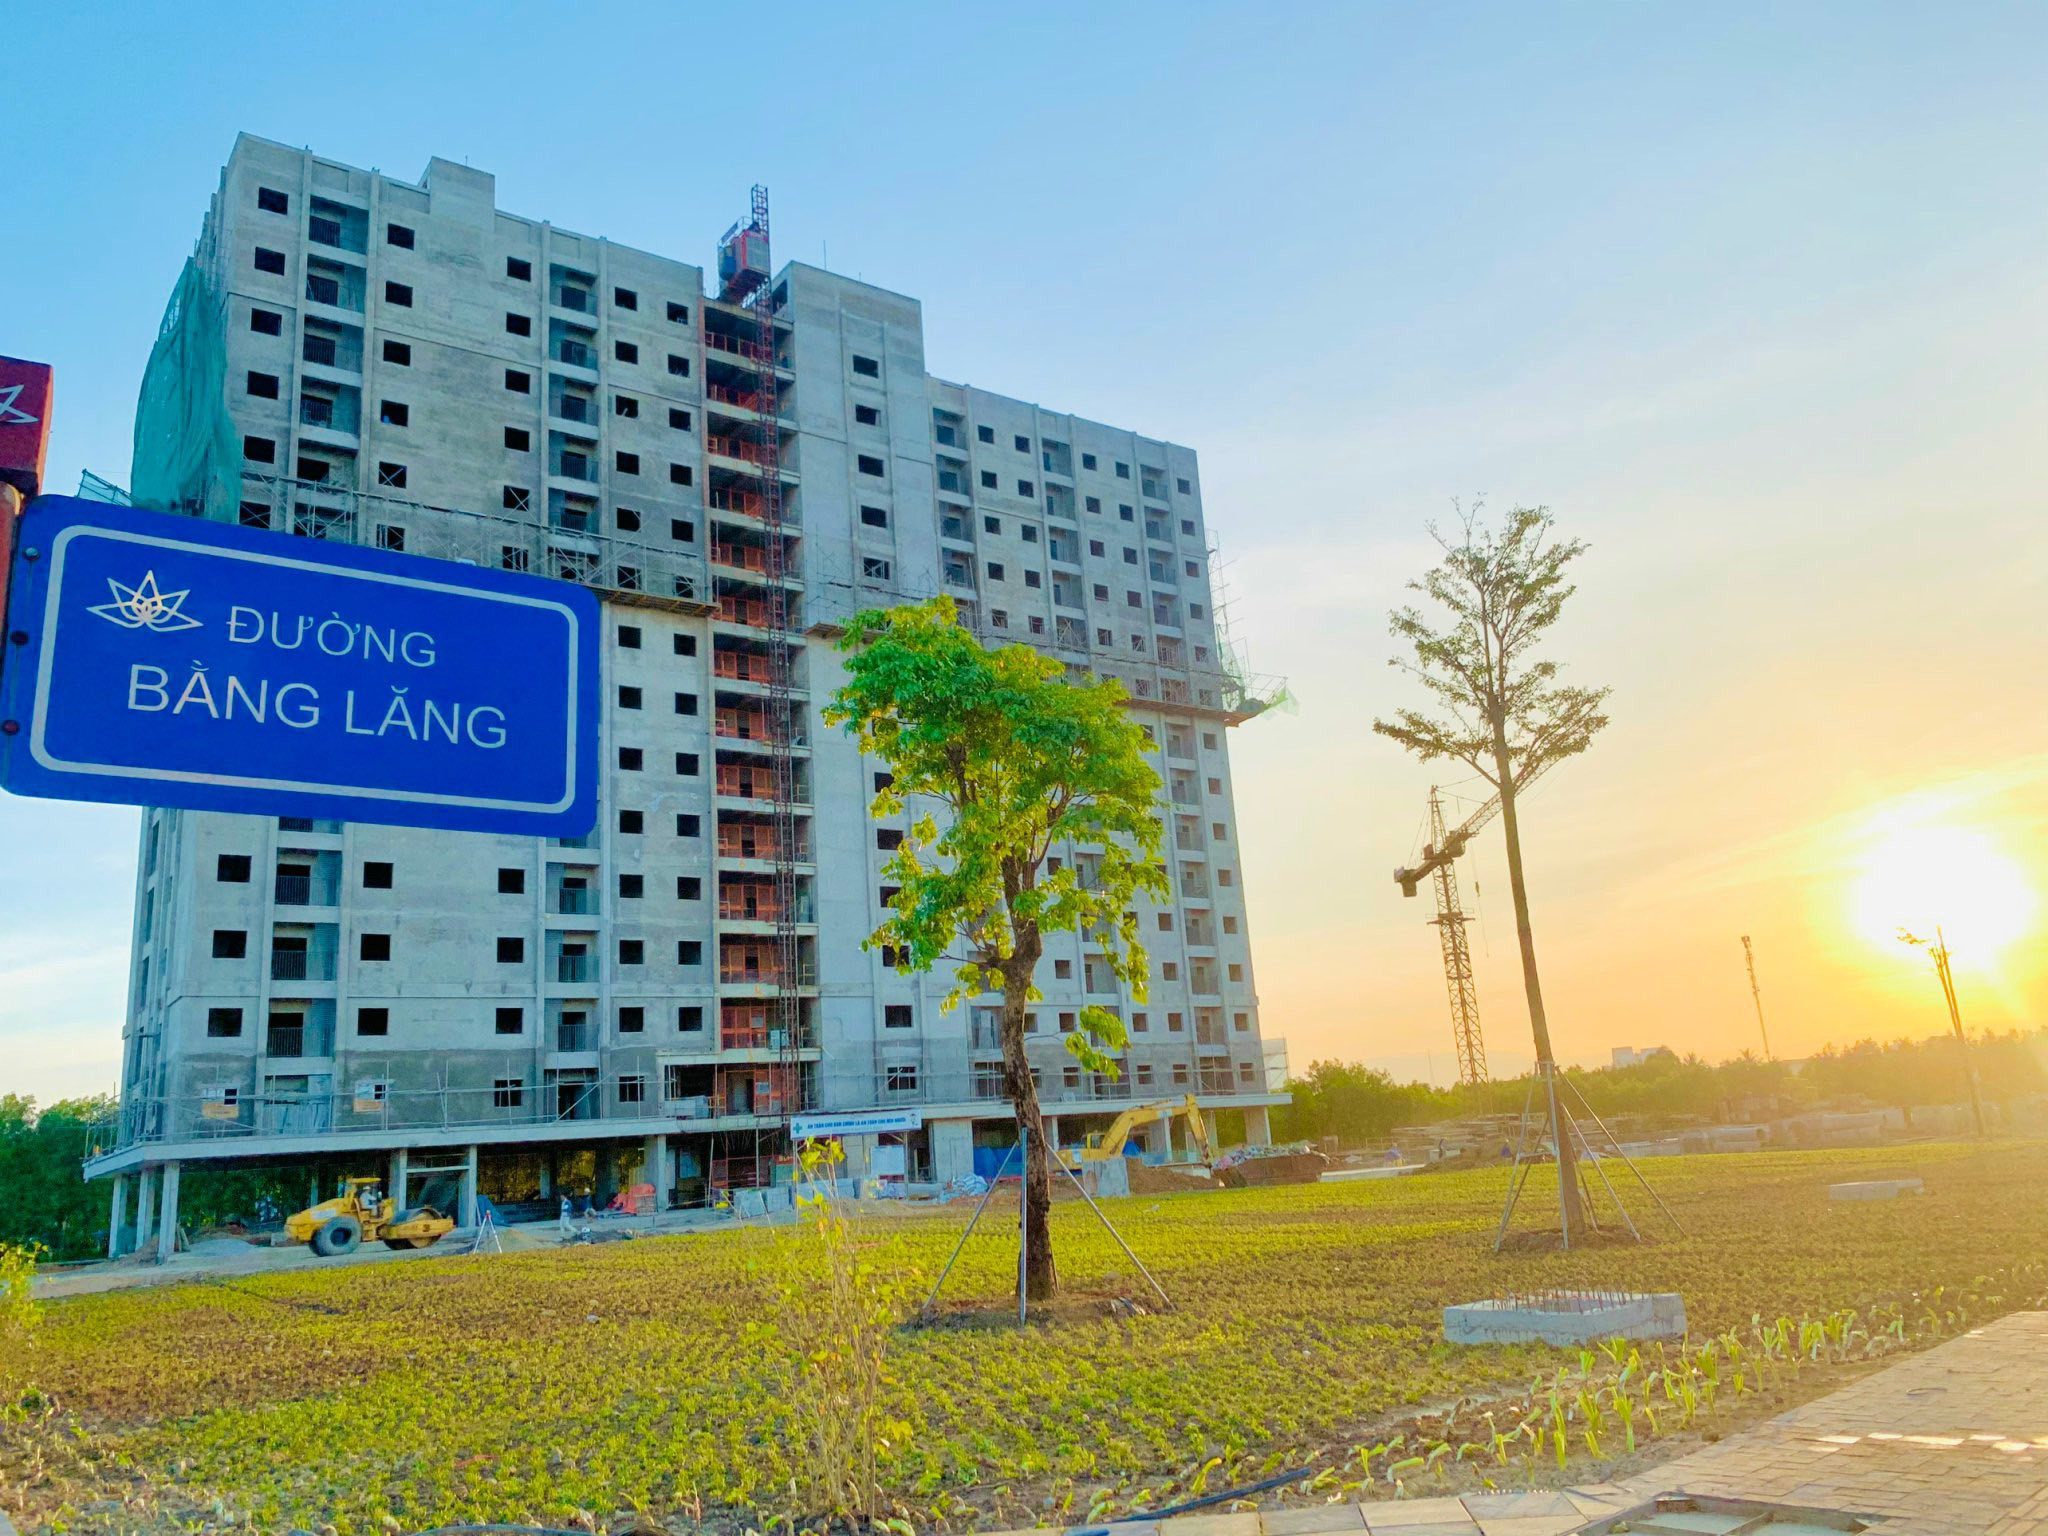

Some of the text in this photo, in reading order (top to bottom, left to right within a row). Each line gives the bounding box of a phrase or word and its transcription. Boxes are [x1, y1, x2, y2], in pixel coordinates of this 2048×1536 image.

[226, 605, 437, 667] ĐƯỜNG
[127, 658, 508, 749] BẰNG LĂNG
